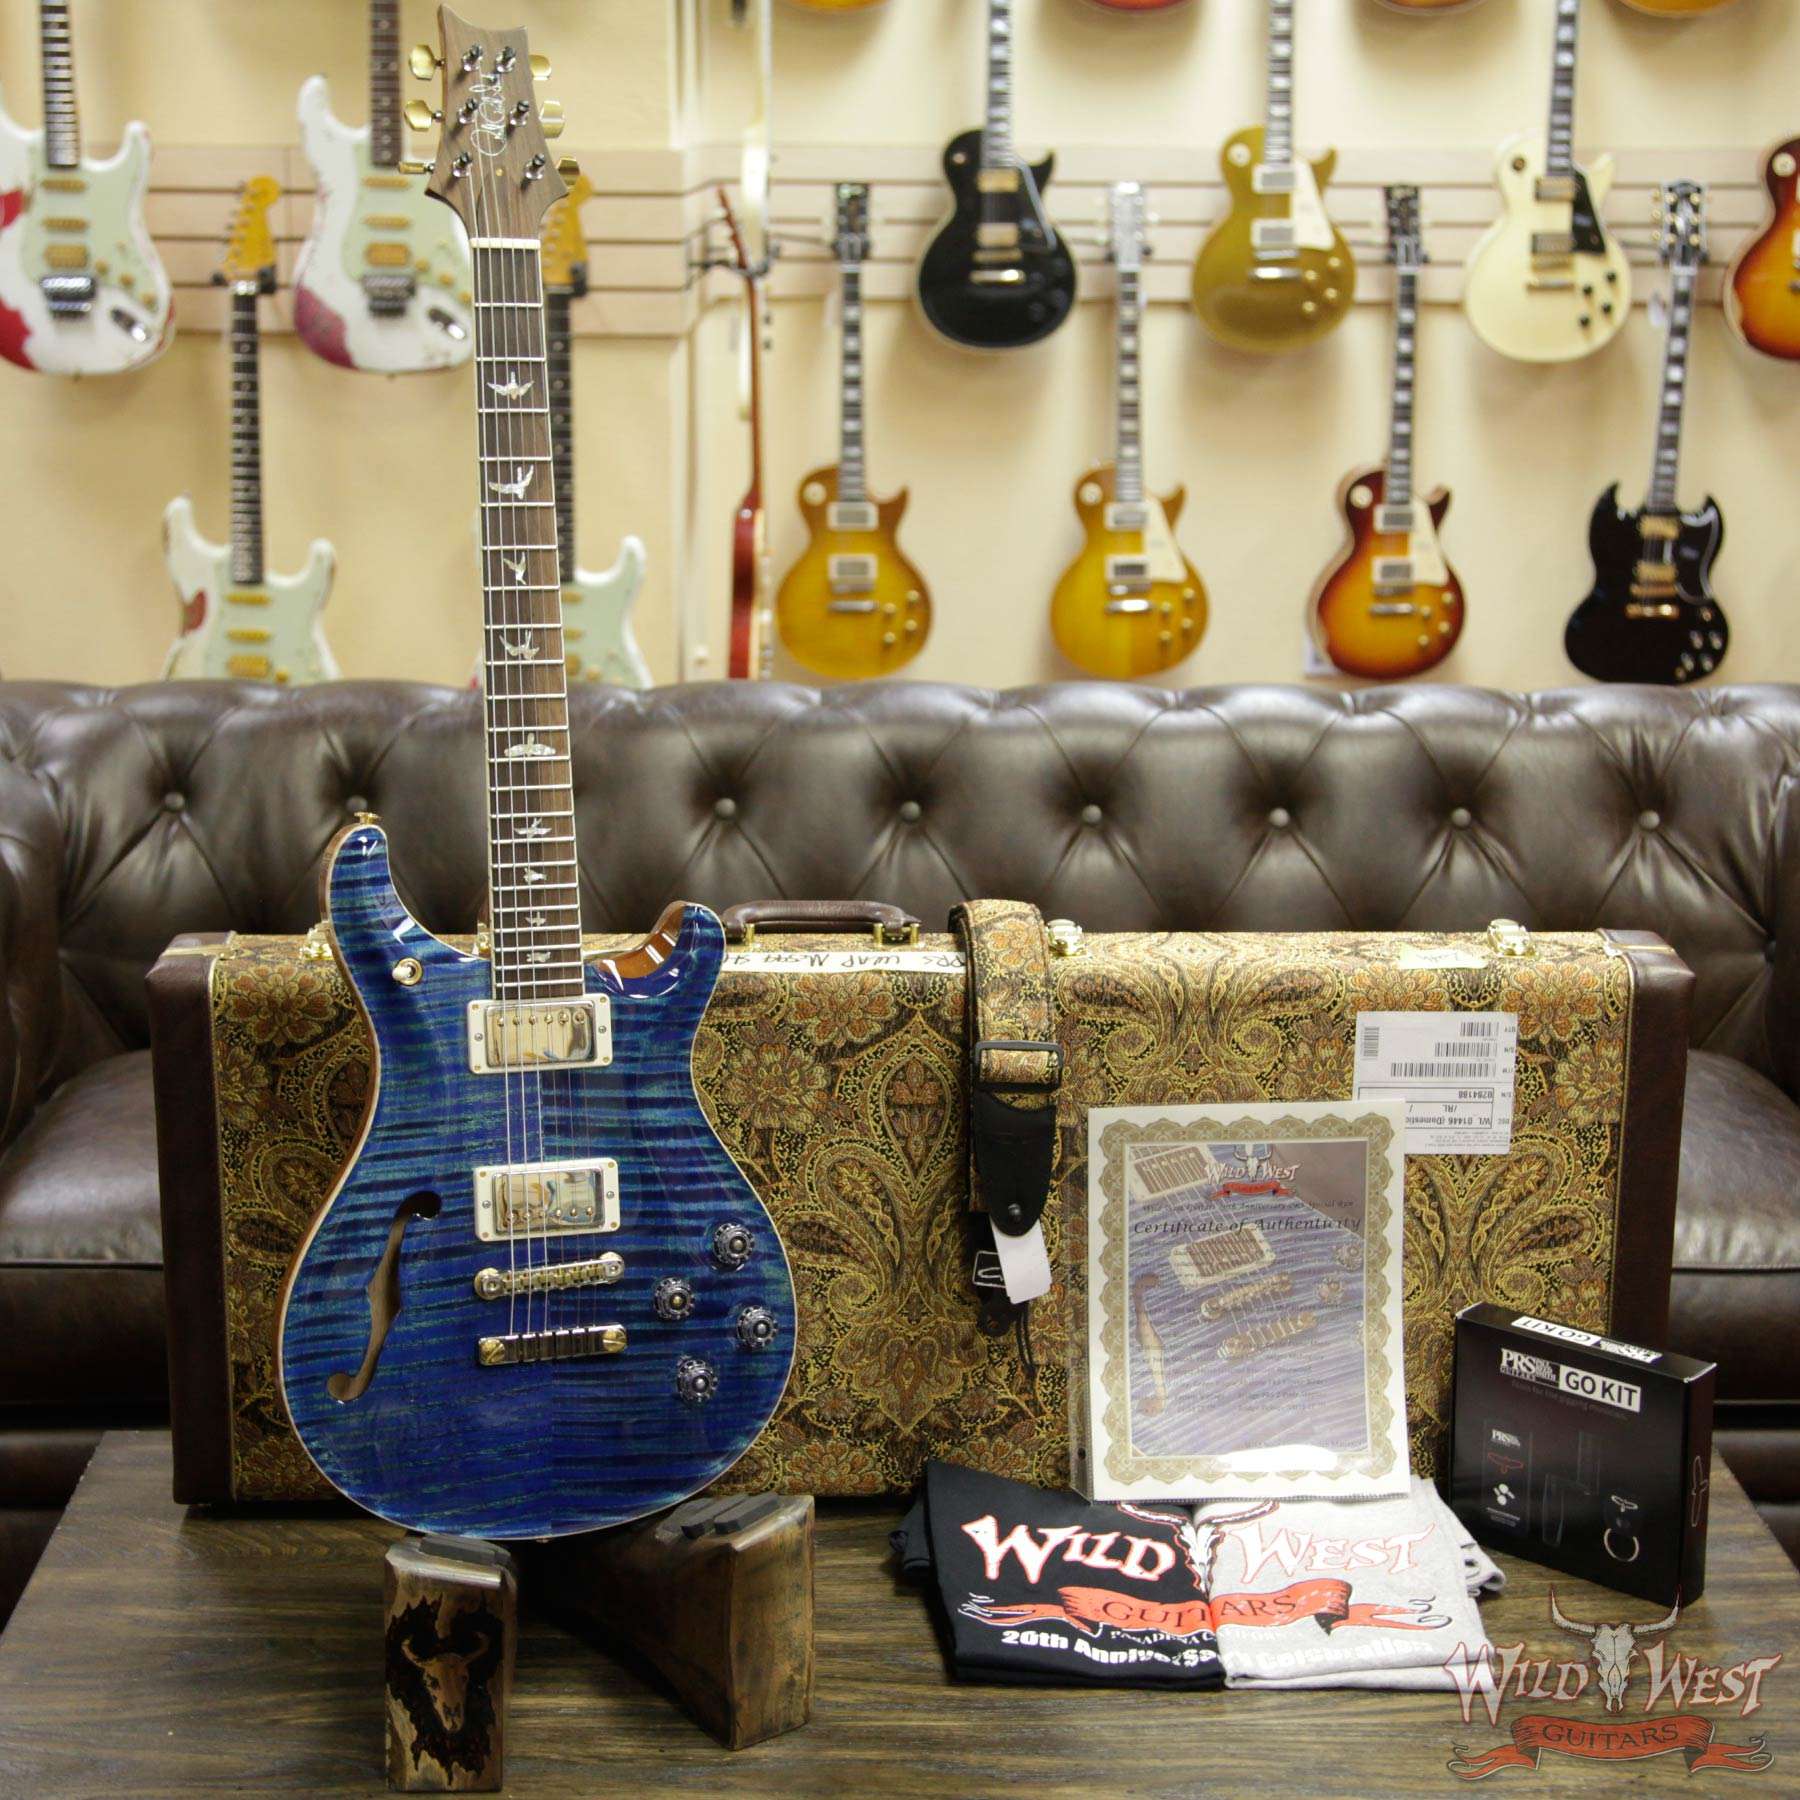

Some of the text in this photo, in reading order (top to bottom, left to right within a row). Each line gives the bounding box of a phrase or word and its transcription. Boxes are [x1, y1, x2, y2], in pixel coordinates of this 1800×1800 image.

[1134, 1219, 1224, 1234] Certificate
[1229, 1216, 1248, 1234] of
[1501, 1348, 1536, 1374] PRS
[1565, 1371, 1596, 1395] GO
[1601, 1381, 1637, 1406] KIT
[961, 1515, 1436, 1584] WILD WEST
[1001, 1630, 1068, 1649] 20th
